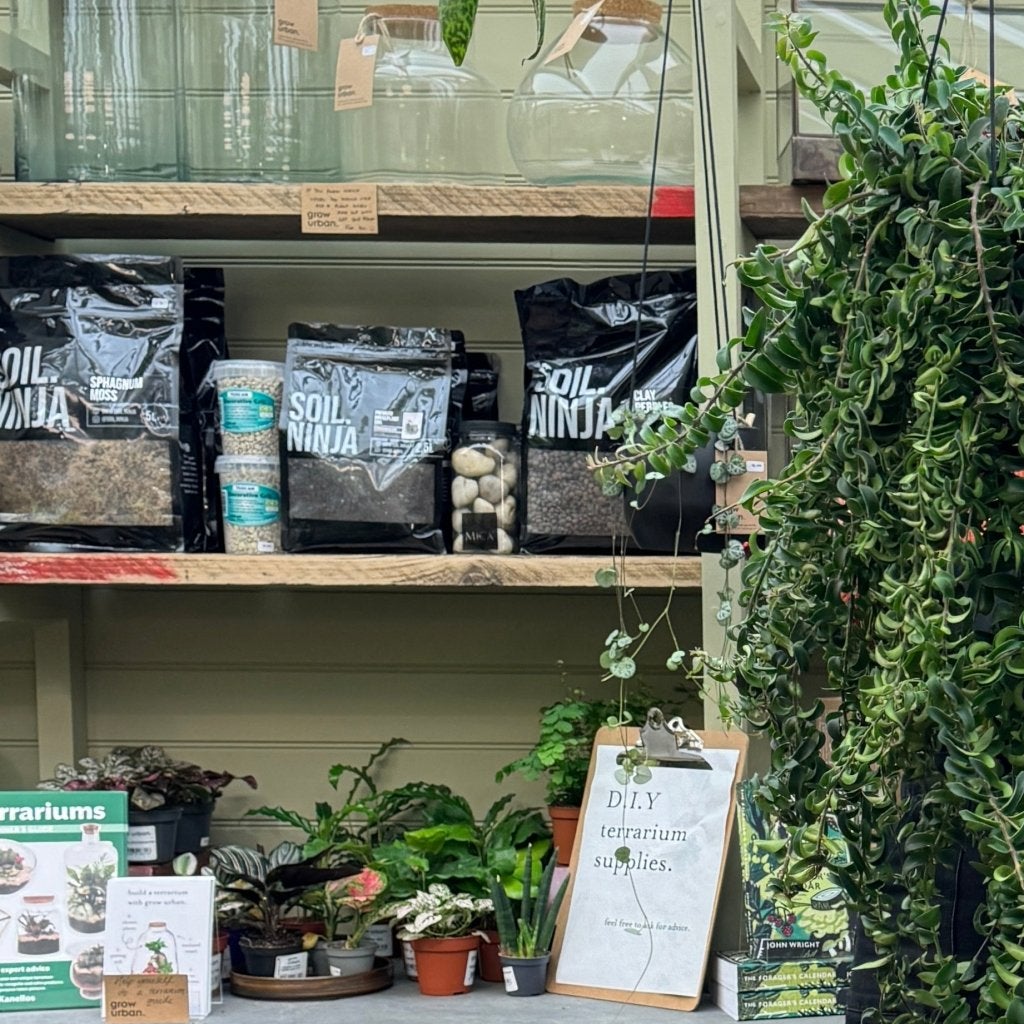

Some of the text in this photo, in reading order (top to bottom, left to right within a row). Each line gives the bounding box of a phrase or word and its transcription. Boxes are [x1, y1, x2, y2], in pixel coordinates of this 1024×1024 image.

[307, 212, 330, 220] grow
[0, 346, 58, 389] OIL.
[90, 376, 143, 389] SPHAGNUM
[535, 363, 606, 398] SOIL.
[90, 389, 118, 401] MOSS
[633, 390, 655, 401] CLAY
[289, 392, 351, 425] SOIL.
[529, 394, 616, 440] NINJA
[287, 422, 358, 455] NINJA
[606, 790, 661, 810] D.I.Y
[601, 824, 687, 841] terrarium
[594, 851, 672, 876] supplies.
[605, 917, 618, 927] feel
[619, 919, 633, 928] free
[655, 921, 667, 931] for
[668, 922, 691, 932] advice.
[767, 941, 820, 950] JOHN WRIGHT
[26, 965, 51, 973] advice
[110, 1001, 136, 1010] grow
[111, 1009, 146, 1017] urban.
